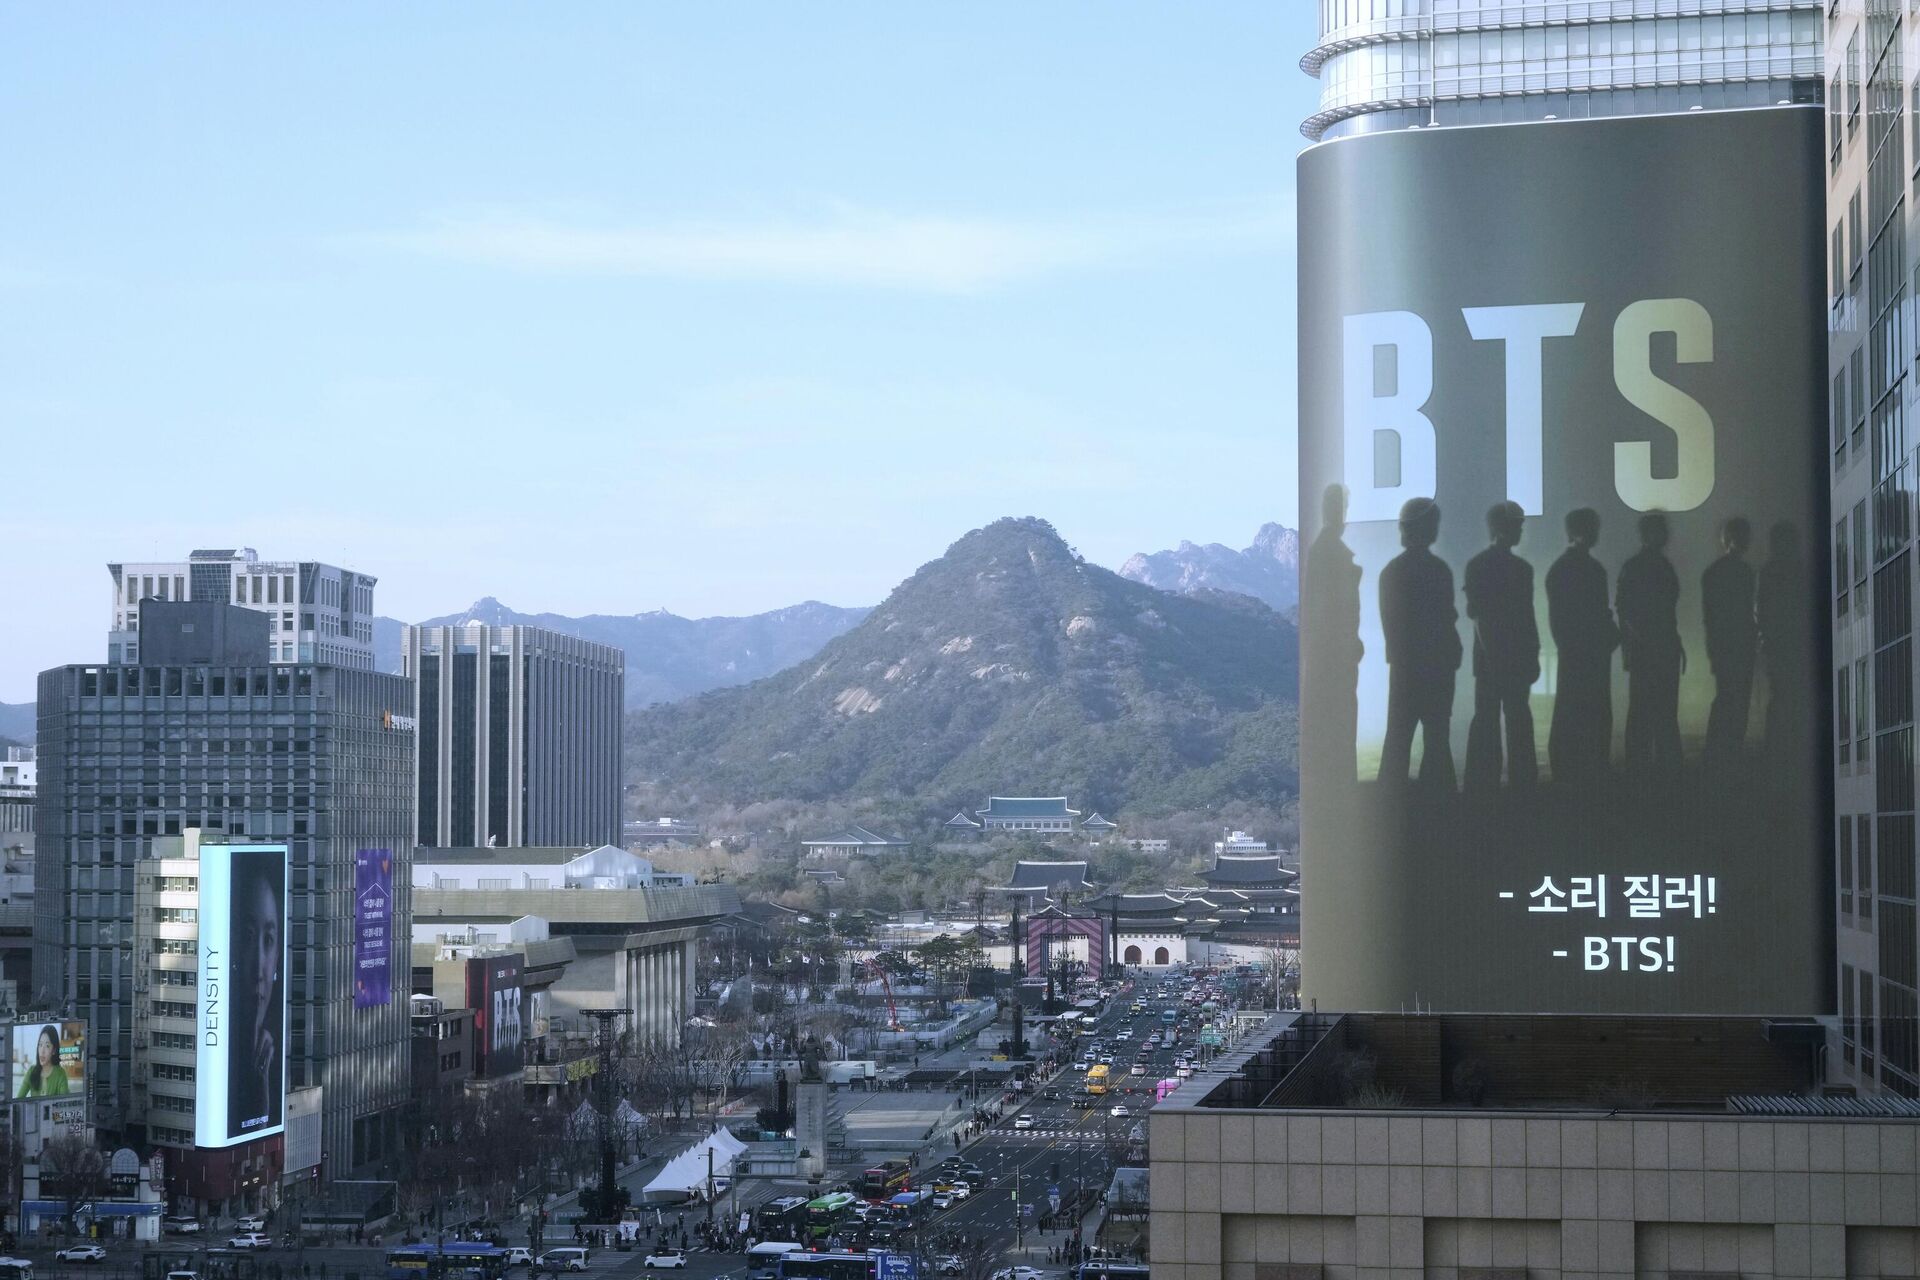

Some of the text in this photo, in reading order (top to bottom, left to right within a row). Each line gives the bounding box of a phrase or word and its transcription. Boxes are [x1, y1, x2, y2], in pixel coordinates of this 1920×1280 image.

[1343, 298, 1715, 522] BTS
[1528, 874, 1606, 918] 소리
[1623, 874, 1716, 918] 질러!
[1584, 936, 1675, 972] BTS!
[206, 946, 219, 1047] DENSITY
